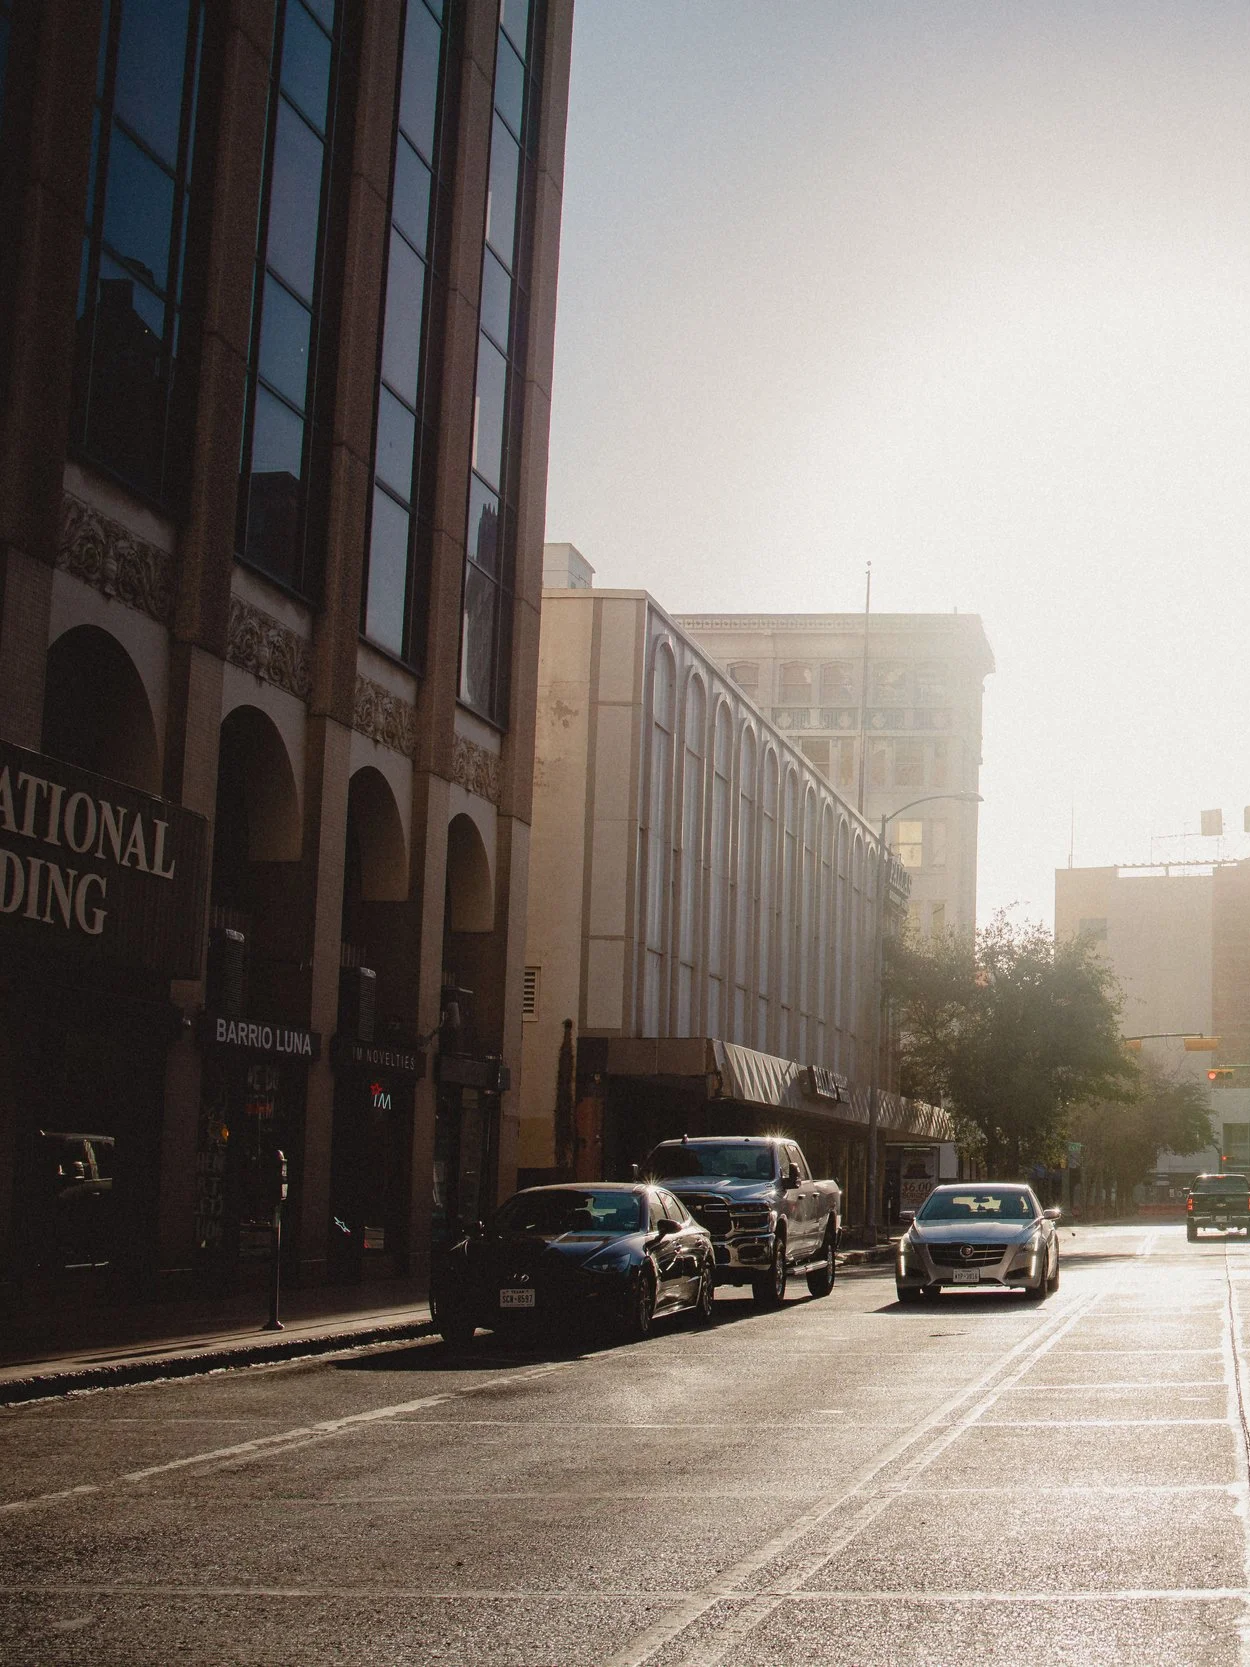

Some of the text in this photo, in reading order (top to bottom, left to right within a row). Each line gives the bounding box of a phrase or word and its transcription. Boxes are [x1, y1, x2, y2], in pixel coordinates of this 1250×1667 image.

[216, 1018, 312, 1056] BARRIO LUNA
[367, 1048, 416, 1071] NOVELTIES
